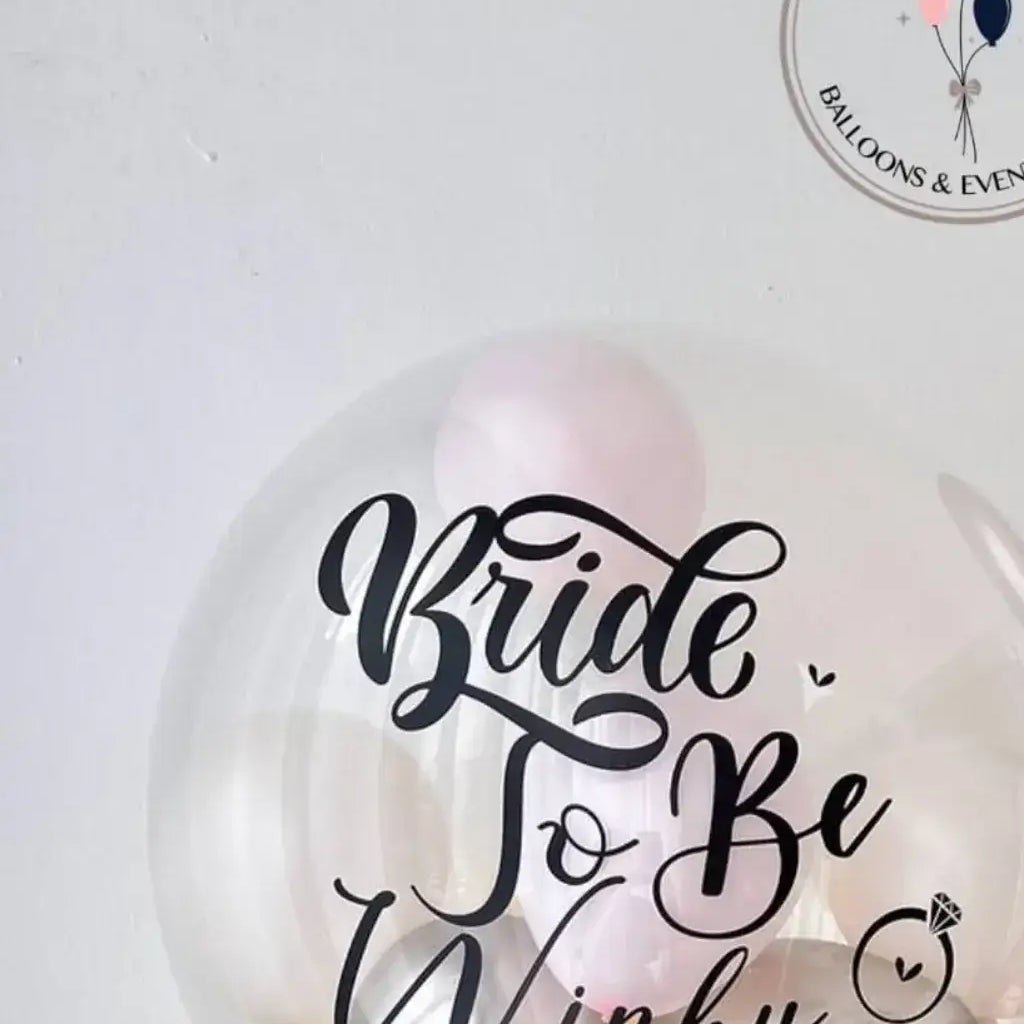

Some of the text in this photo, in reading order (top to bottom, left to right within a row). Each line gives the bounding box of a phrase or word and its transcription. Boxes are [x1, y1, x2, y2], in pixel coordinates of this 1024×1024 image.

[318, 492, 788, 732] Bride
[411, 692, 893, 940] To Be
